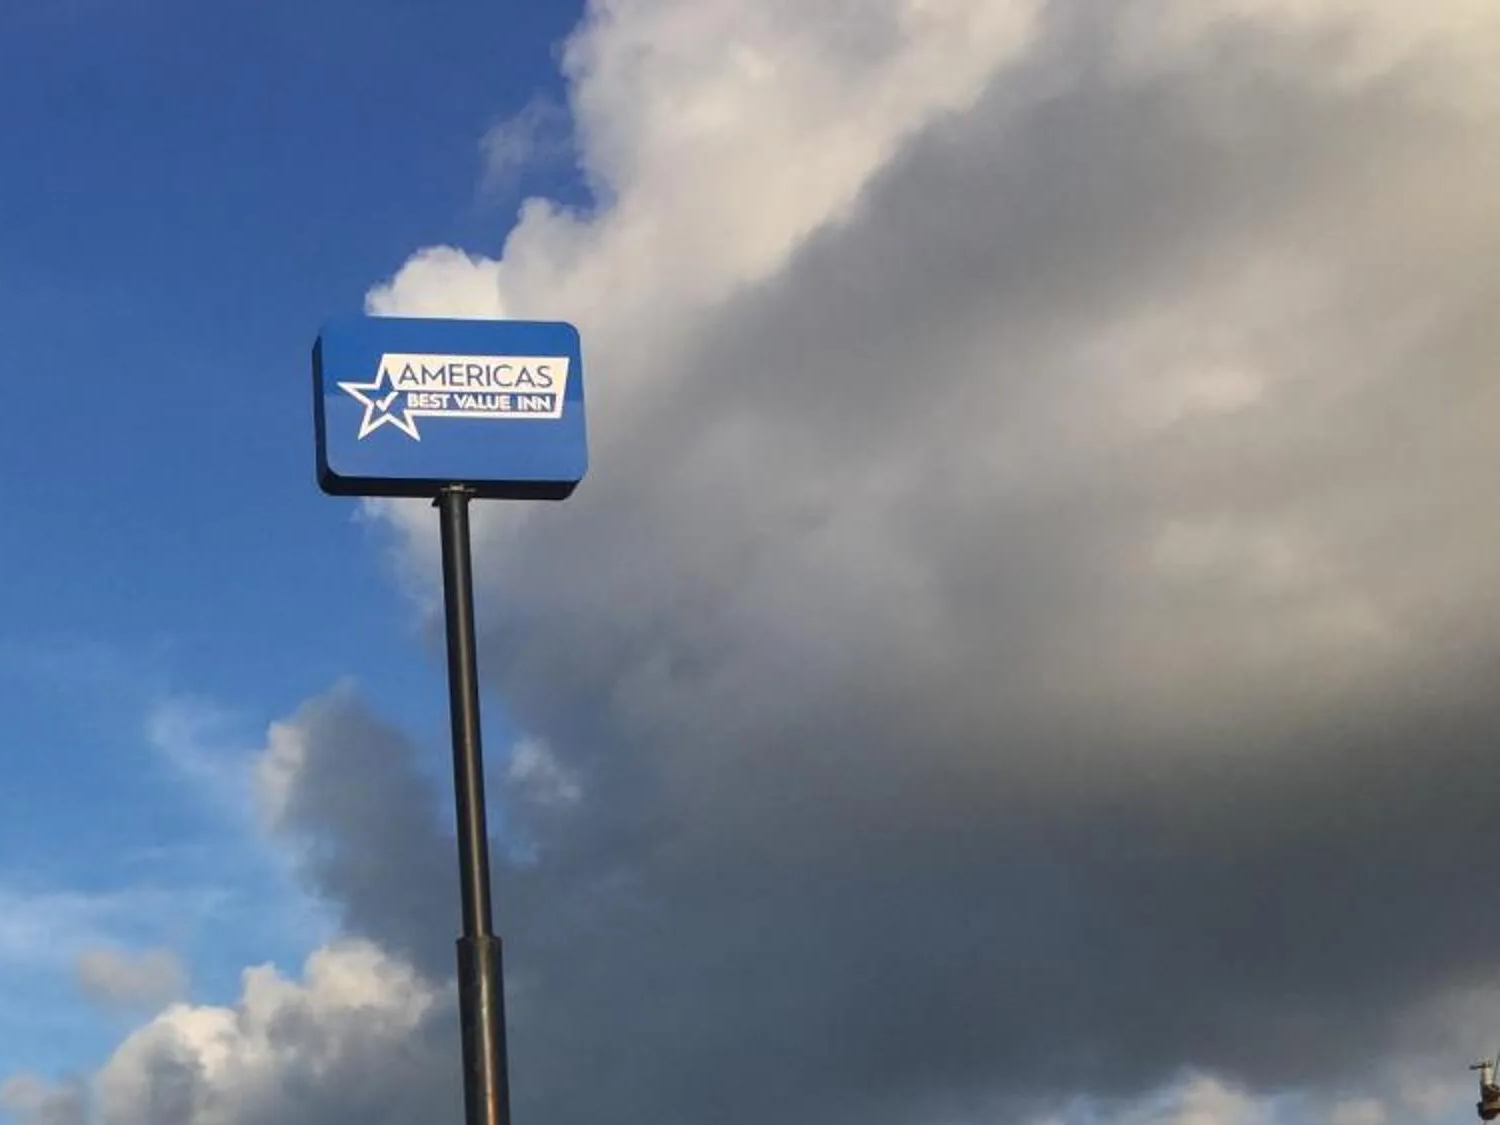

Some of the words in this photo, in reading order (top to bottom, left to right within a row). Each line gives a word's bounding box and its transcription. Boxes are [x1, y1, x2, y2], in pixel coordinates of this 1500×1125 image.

[399, 363, 553, 388] AMERICAS
[408, 393, 450, 409] BEST
[455, 394, 510, 410] VALUE
[517, 395, 551, 411] INN
